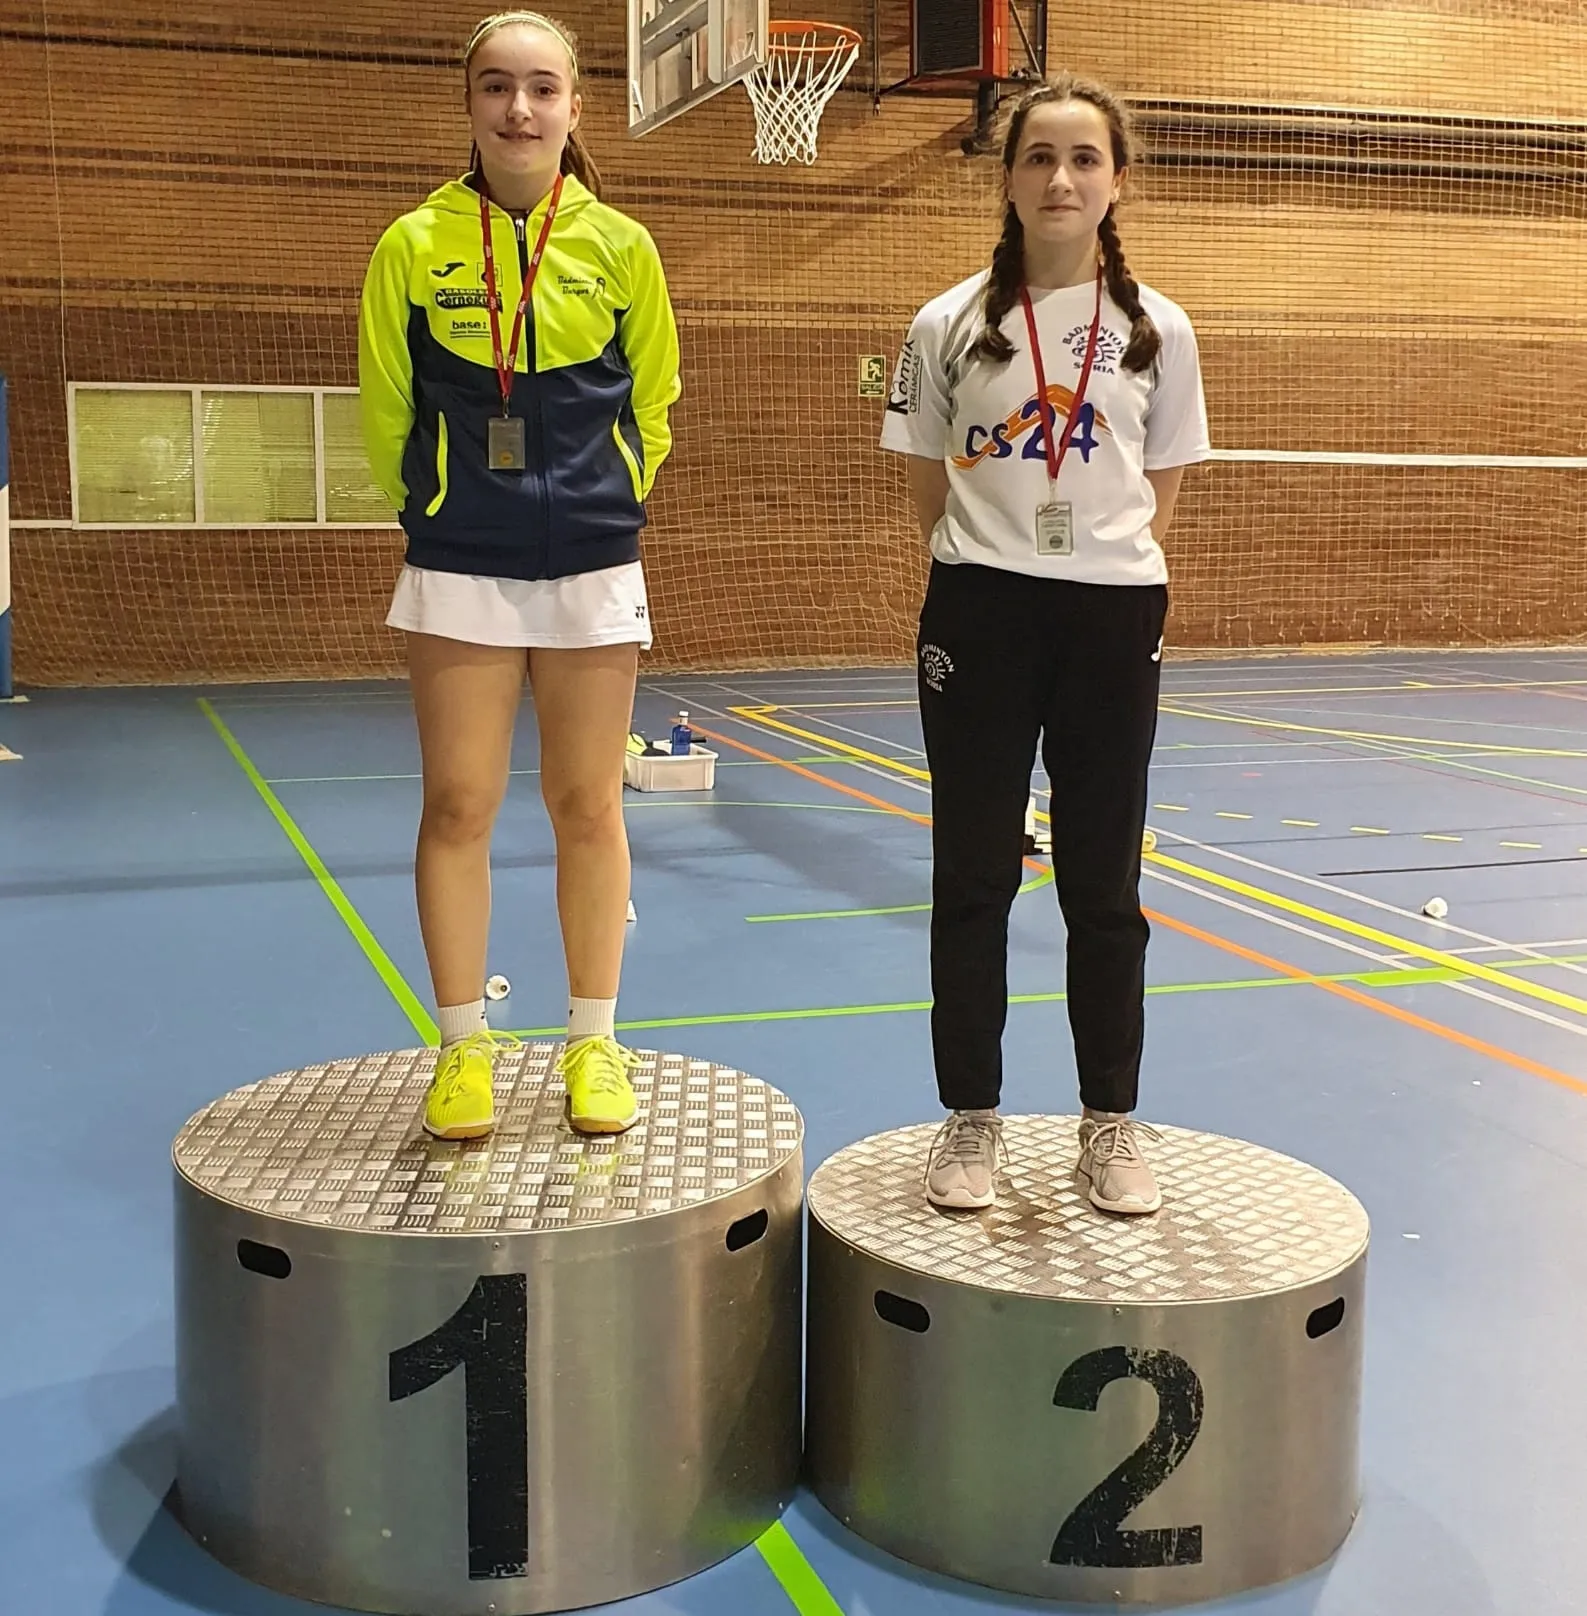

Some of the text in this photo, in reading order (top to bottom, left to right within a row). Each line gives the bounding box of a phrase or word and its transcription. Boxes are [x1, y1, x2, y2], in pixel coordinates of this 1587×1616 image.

[1073, 361, 1115, 375] SRIA
[389, 1273, 528, 1580] 1
[1049, 1345, 1204, 1568] 2
